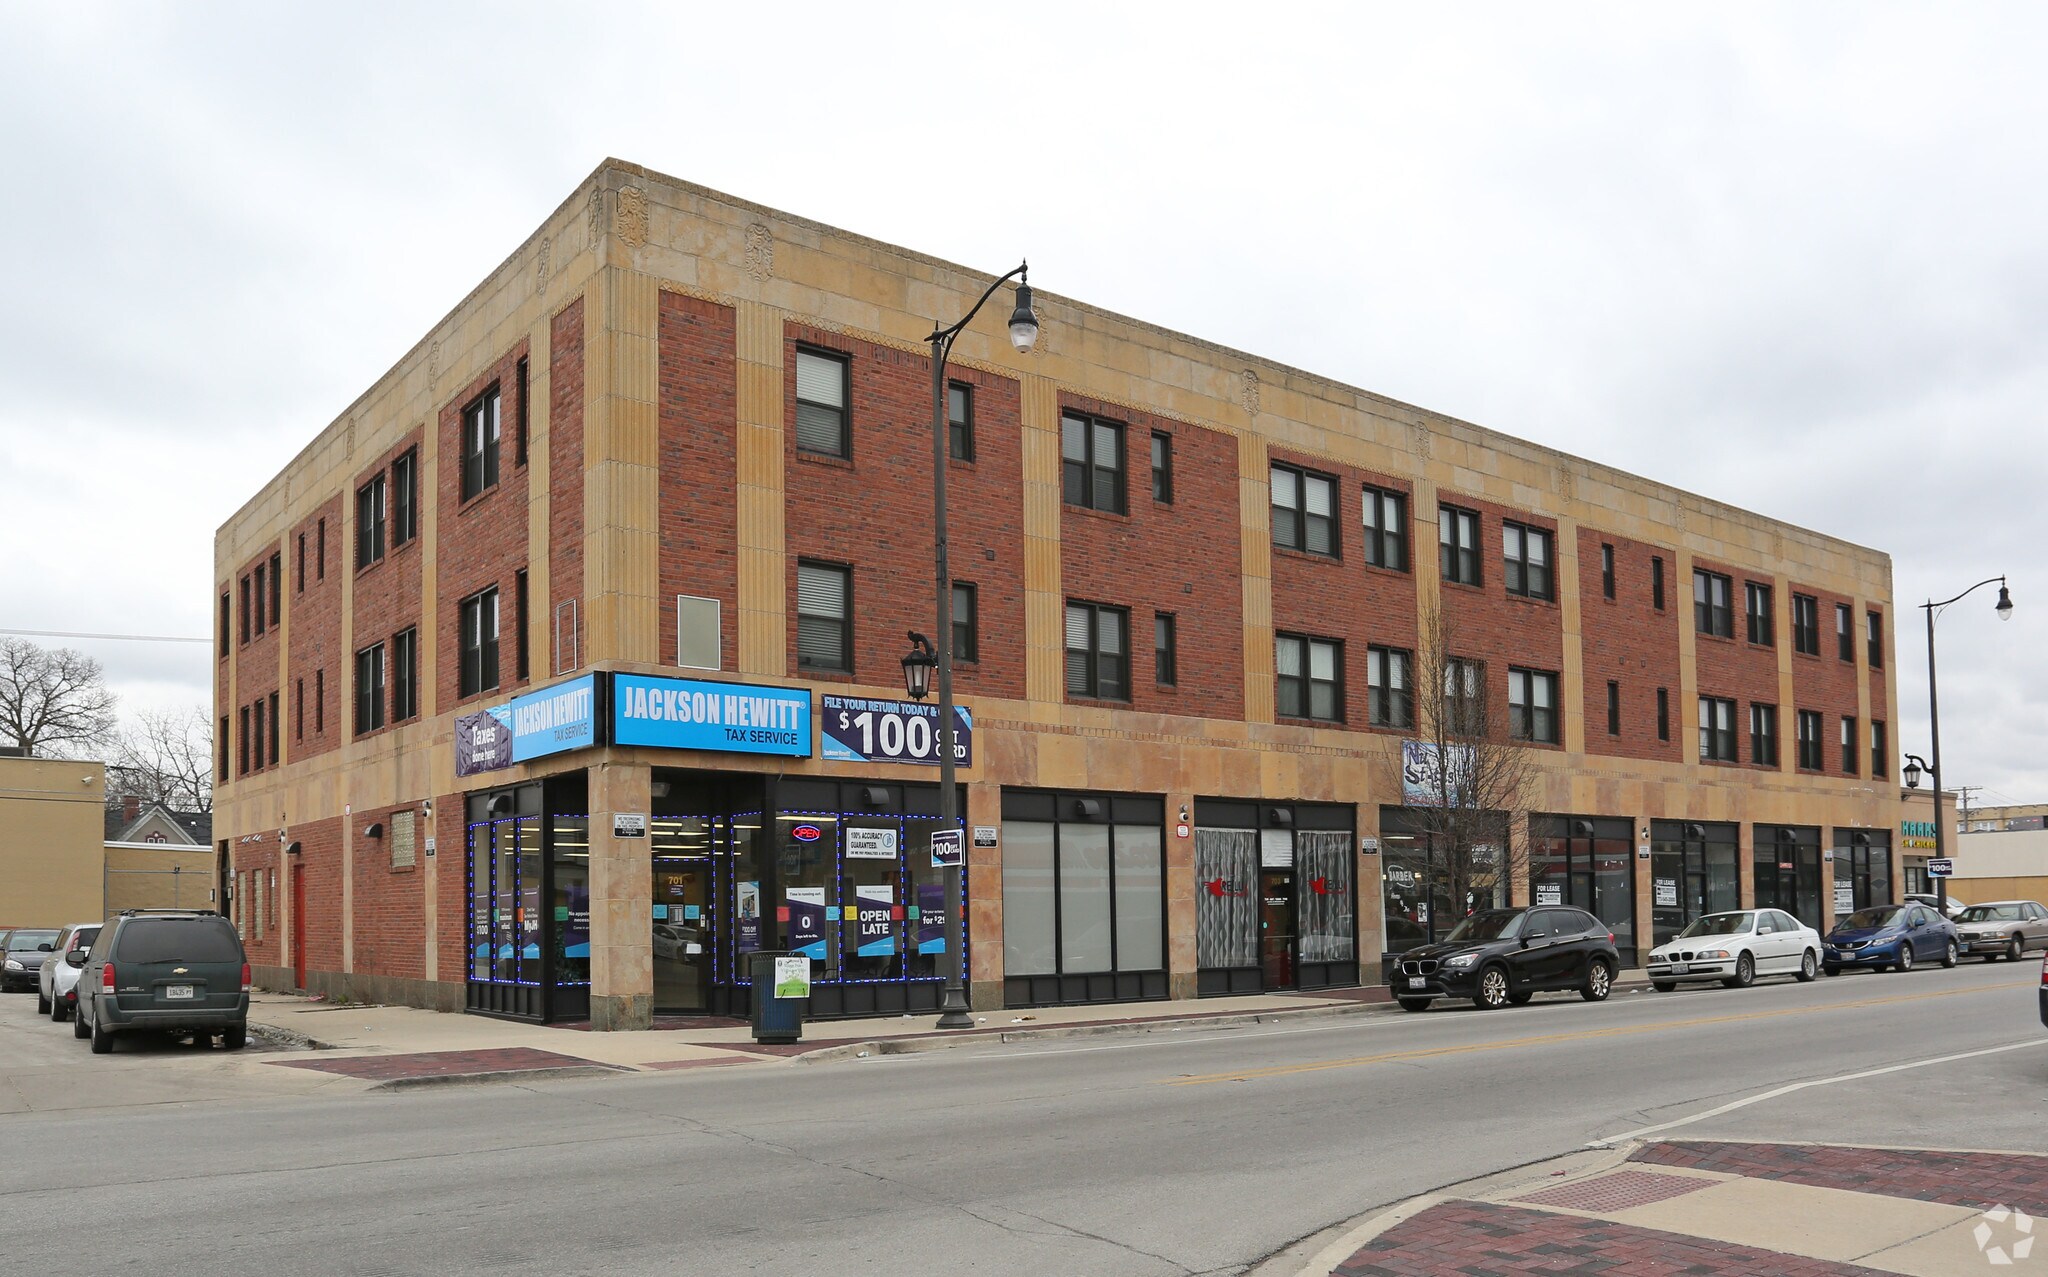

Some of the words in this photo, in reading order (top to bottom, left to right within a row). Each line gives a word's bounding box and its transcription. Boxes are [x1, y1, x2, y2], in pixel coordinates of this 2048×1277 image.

[624, 687, 718, 723] JACKSON
[824, 697, 842, 709] FILE
[844, 699, 867, 711] YOUR
[868, 701, 900, 714] RETURN
[900, 703, 928, 717] TODAY
[930, 706, 937, 718] &
[514, 699, 552, 738] JACKSON
[553, 688, 589, 727] HEWITT
[472, 725, 496, 746] Taxes
[554, 729, 565, 742] TAX
[565, 722, 588, 740] SERVICE
[725, 728, 747, 743] TAX
[749, 730, 798, 746] SERVICE
[472, 749, 484, 763] done
[484, 748, 496, 760] here
[793, 828, 820, 838] OPEN
[851, 831, 861, 840] 100%
[862, 832, 883, 840] ACCURACY
[668, 876, 684, 885] 701
[1389, 870, 1412, 881] BARBER
[860, 910, 890, 921] OPEN
[923, 916, 933, 924] for
[802, 916, 811, 929] 0
[862, 923, 889, 935] LATE
